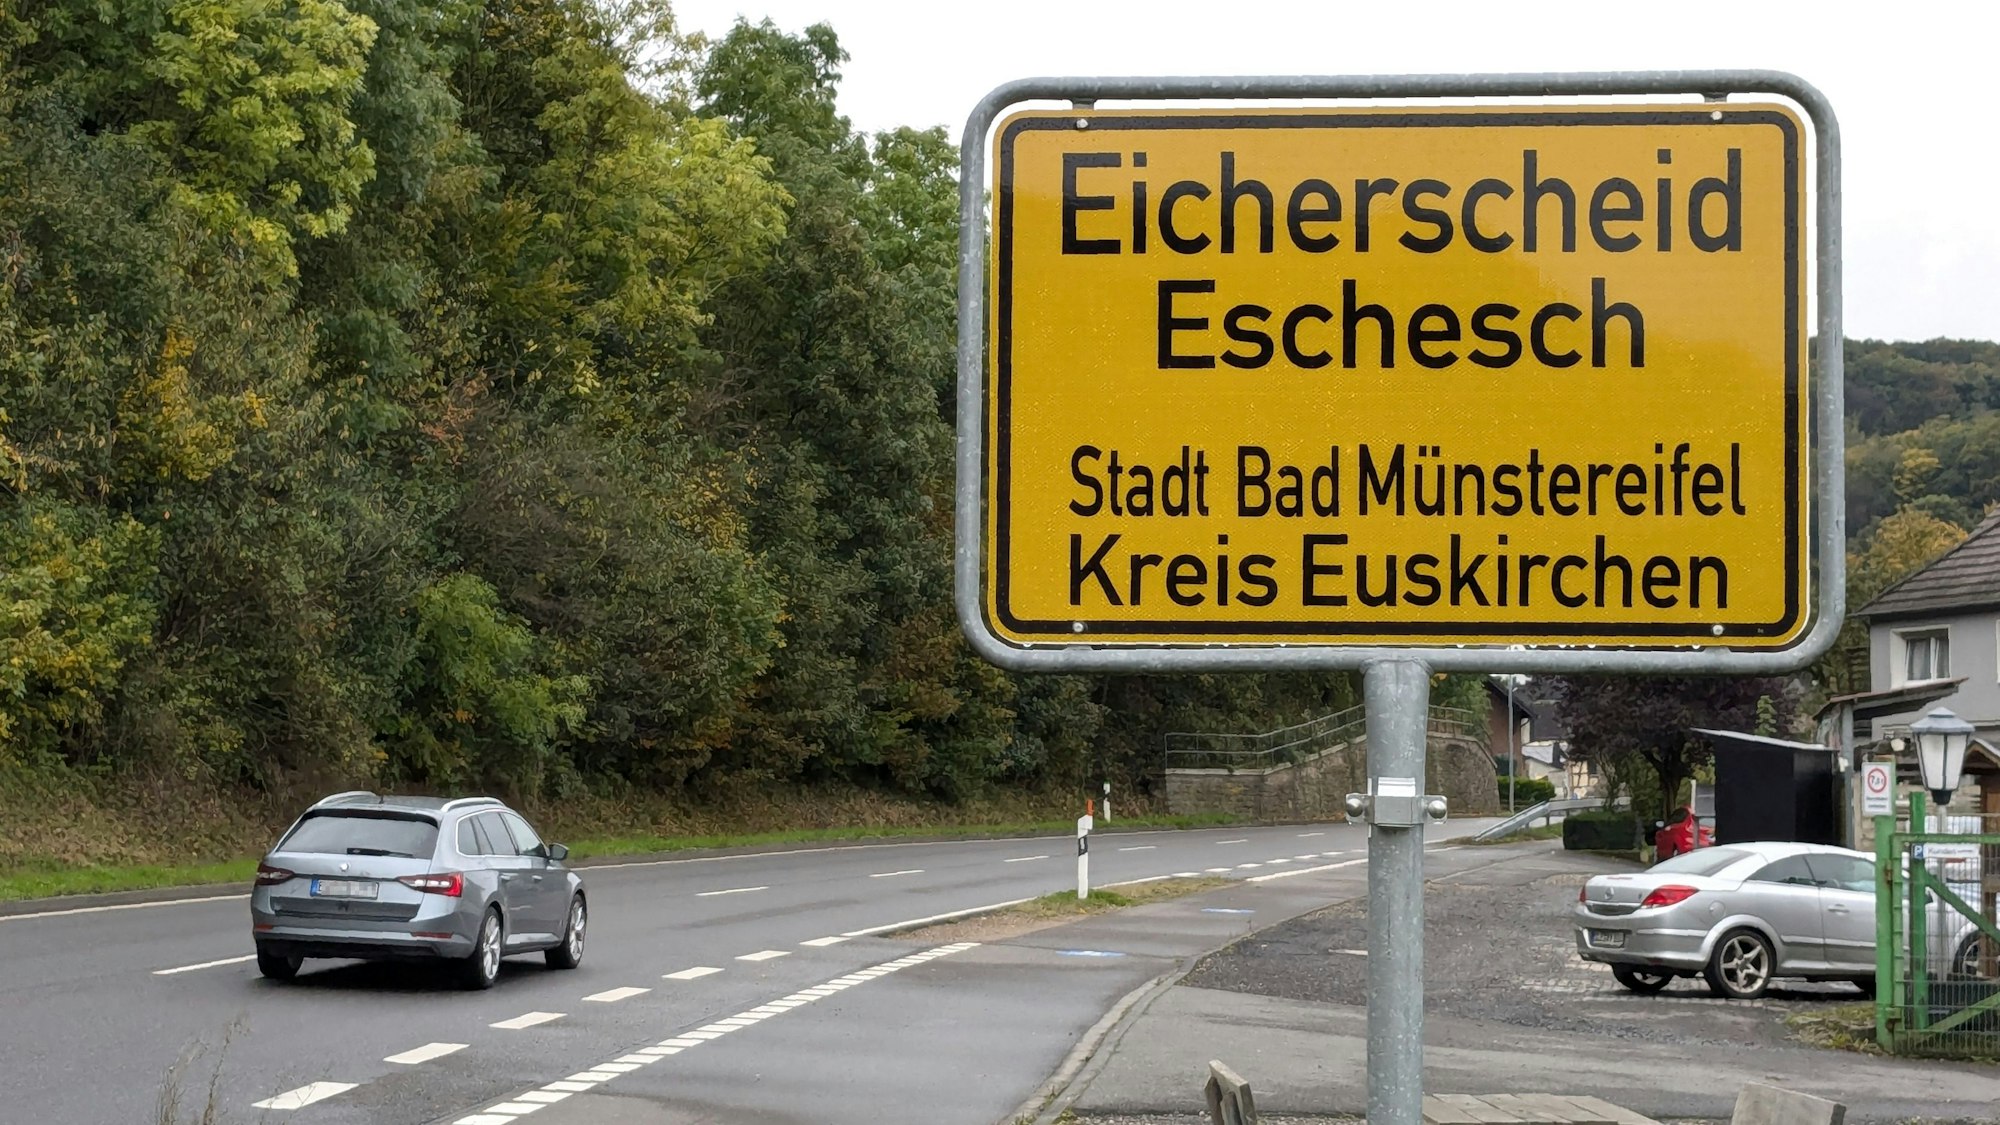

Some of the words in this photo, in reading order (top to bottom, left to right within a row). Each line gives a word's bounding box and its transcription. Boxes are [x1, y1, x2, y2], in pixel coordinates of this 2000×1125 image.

[1061, 148, 1742, 256] Eicherscheid
[1157, 277, 1645, 370] Eschesch
[1068, 444, 1210, 518] Stadt
[1237, 445, 1340, 518] Bad
[1358, 442, 1746, 517] Münstereifel
[1069, 533, 1279, 607] Kreis
[1302, 533, 1728, 610] Euskirchen
